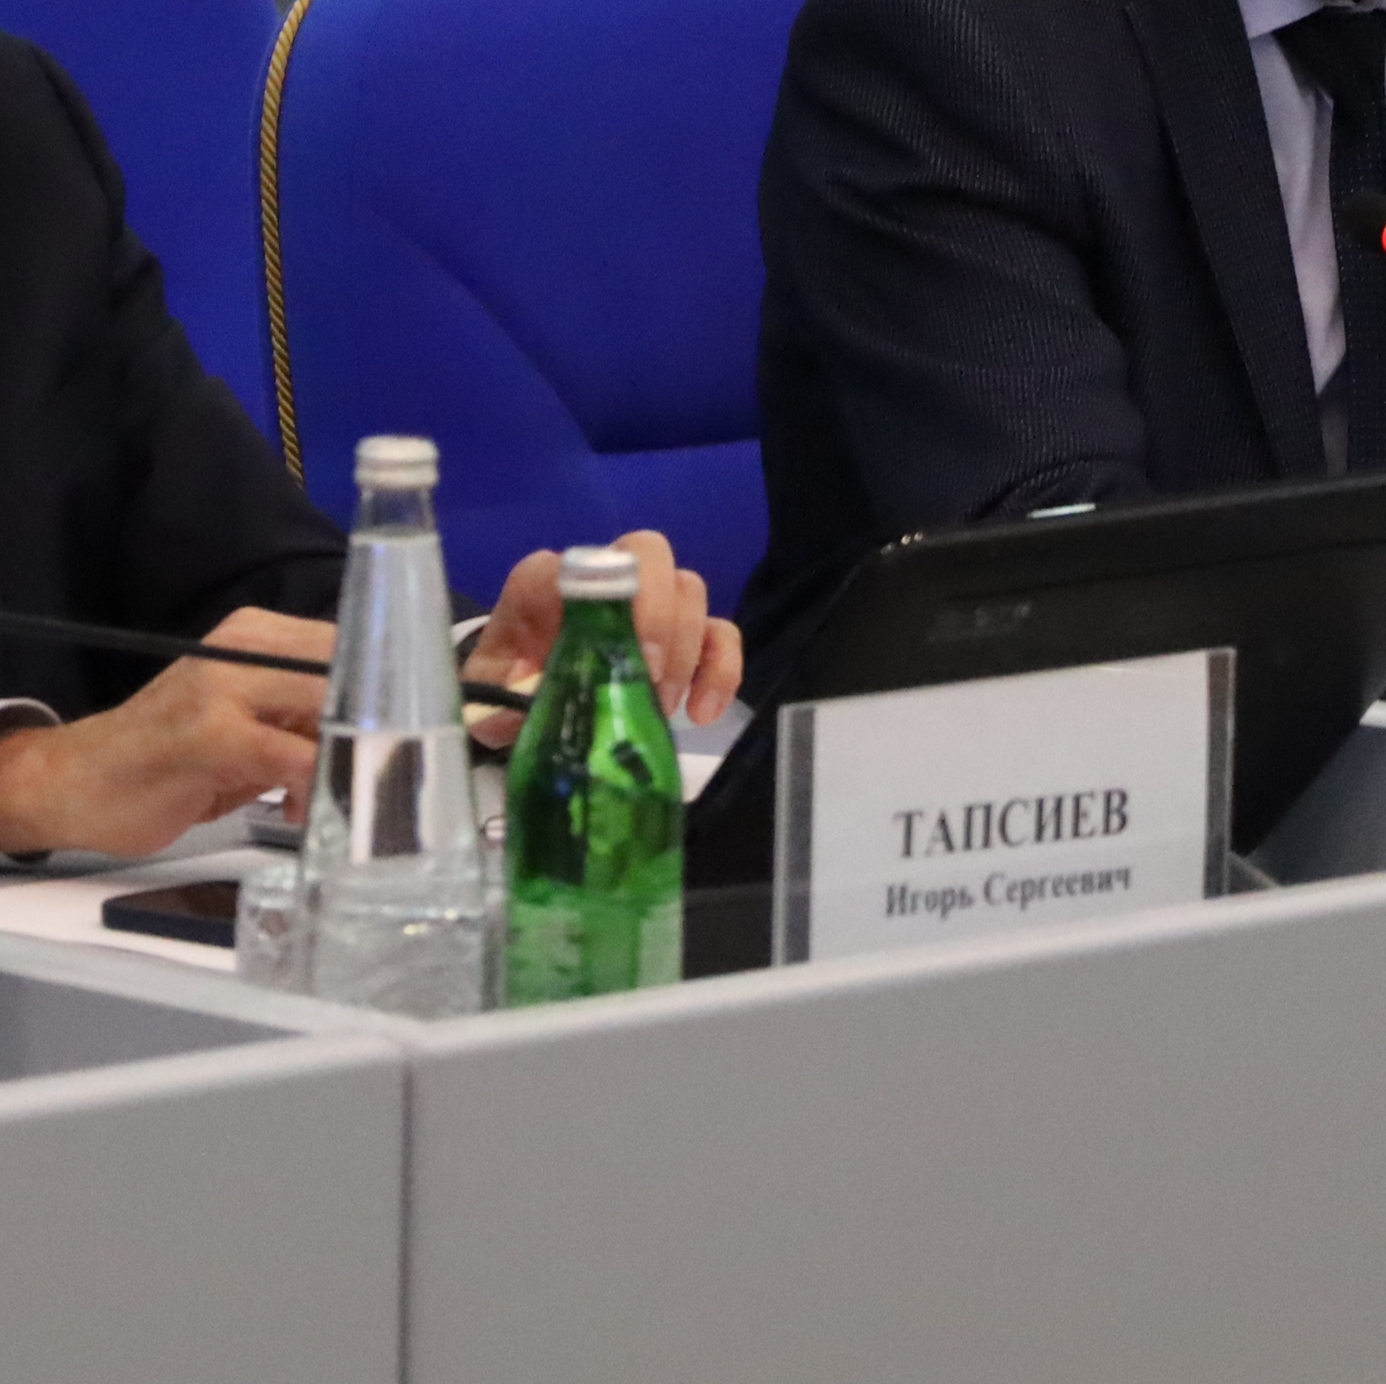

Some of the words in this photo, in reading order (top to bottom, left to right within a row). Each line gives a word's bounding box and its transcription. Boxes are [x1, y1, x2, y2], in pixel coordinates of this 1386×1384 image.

[892, 788, 1129, 858] ТАПСИЕВ
[885, 882, 974, 920] Игорь
[983, 867, 1131, 911] Сергеевич
